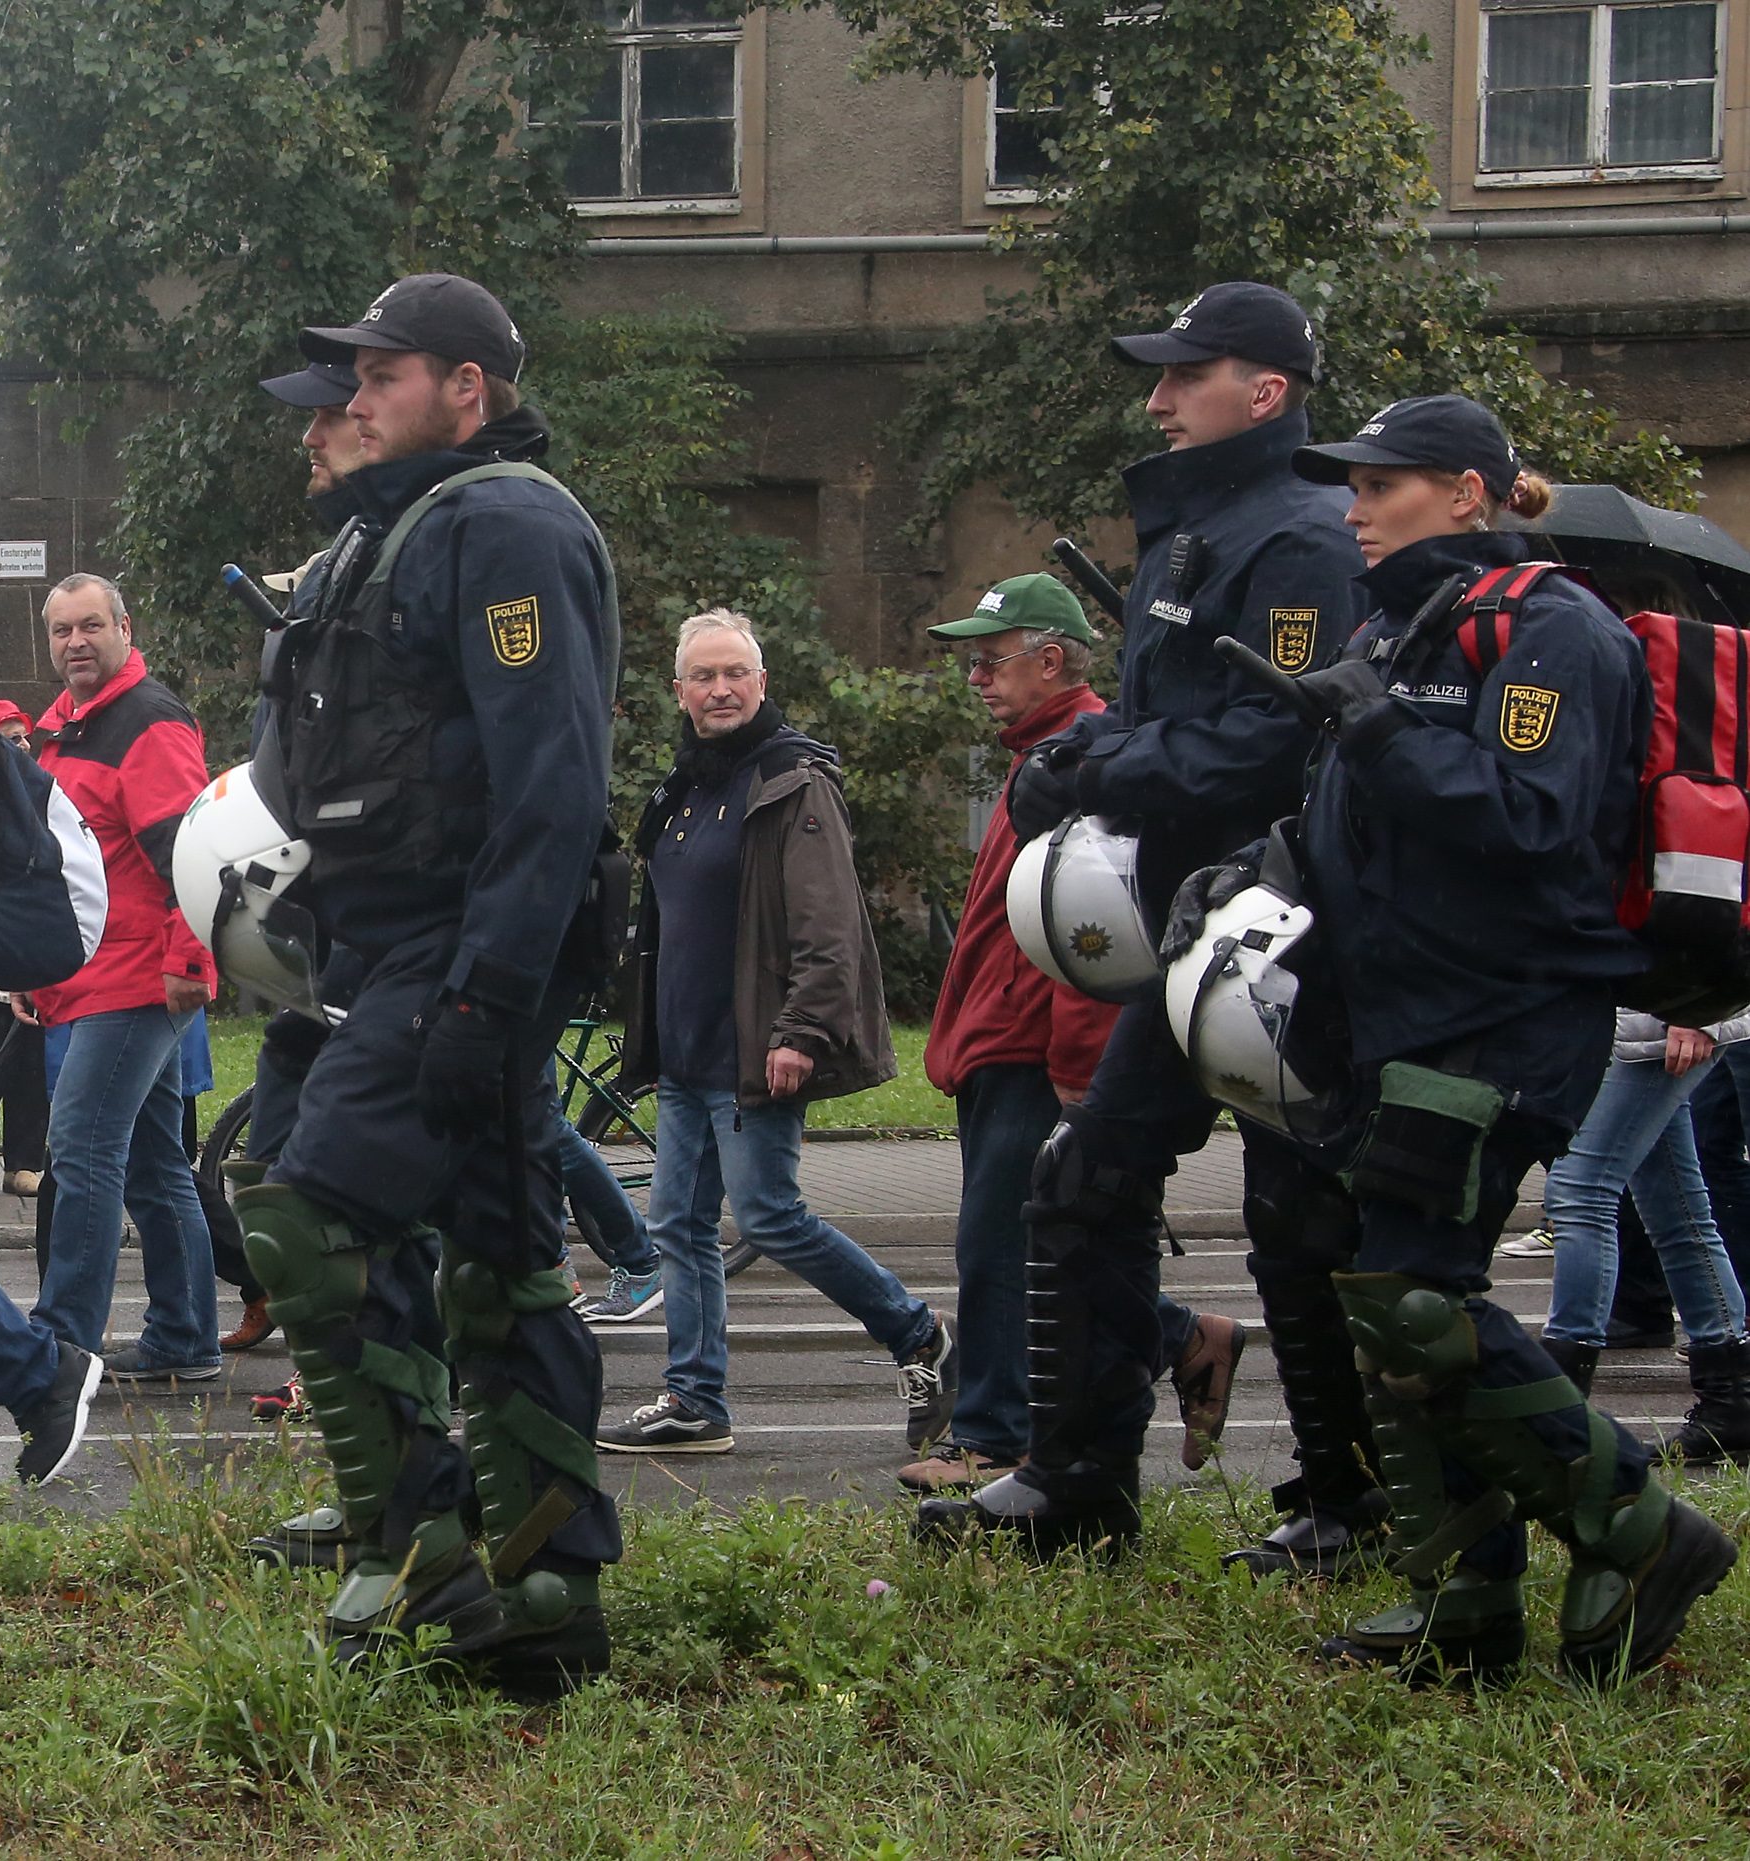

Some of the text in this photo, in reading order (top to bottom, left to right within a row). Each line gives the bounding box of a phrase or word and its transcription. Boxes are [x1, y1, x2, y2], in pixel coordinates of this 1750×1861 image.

[493, 602, 531, 619] POLIZEI
[1274, 612, 1313, 621] POLIZEI
[1419, 684, 1468, 698] POLIZEI
[1510, 689, 1552, 704] POLIZEI
